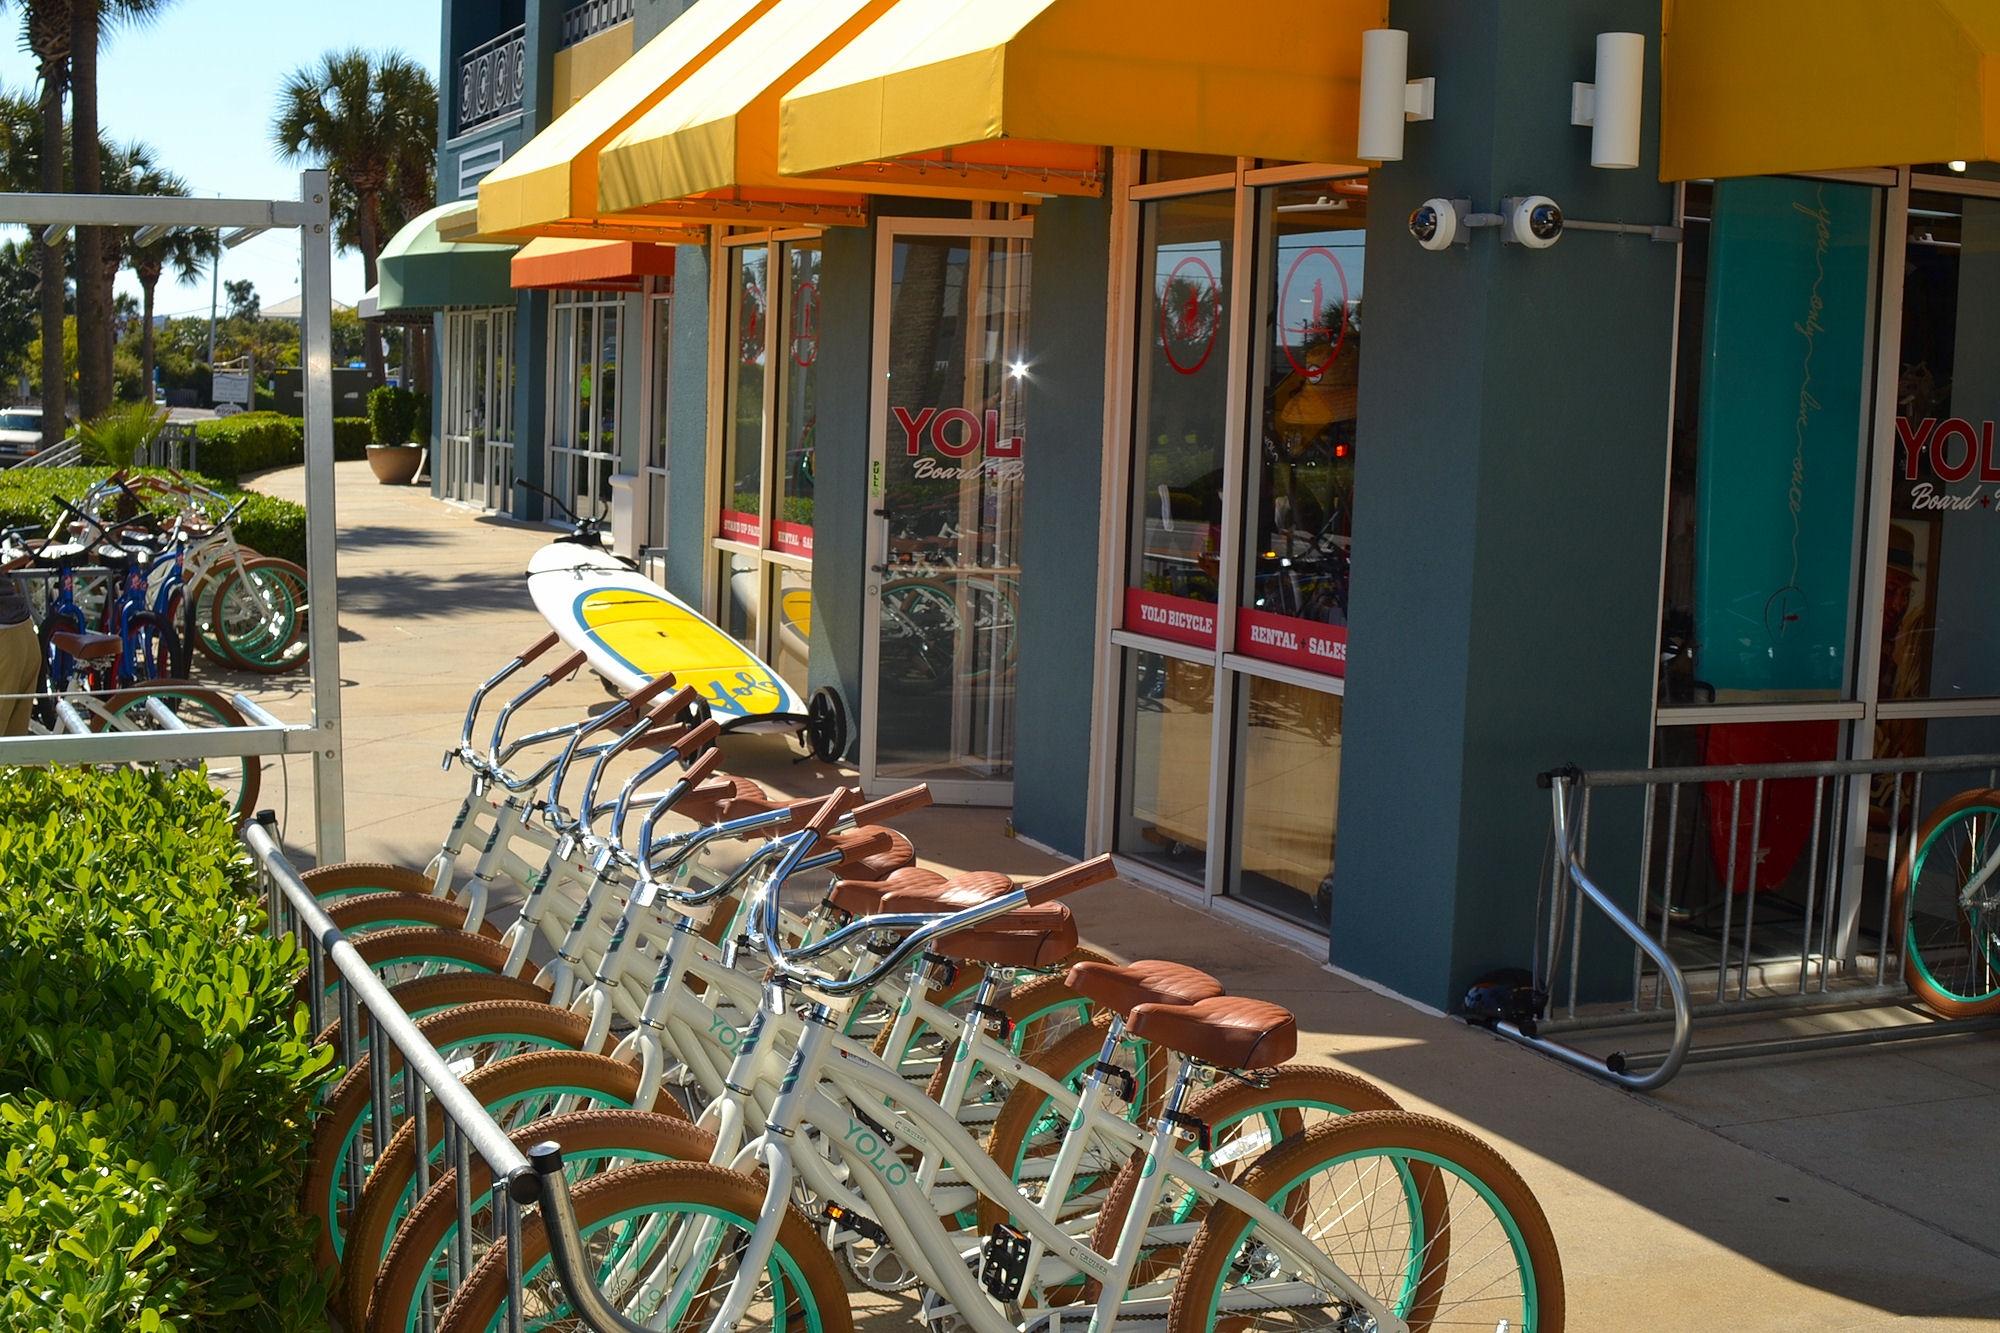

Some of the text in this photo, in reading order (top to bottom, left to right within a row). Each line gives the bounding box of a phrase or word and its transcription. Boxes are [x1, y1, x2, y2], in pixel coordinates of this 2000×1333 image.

[1795, 294, 1825, 337] only
[1799, 389, 1822, 428] live
[891, 406, 1023, 458] YOL
[1895, 416, 2000, 483] YOL
[913, 457, 986, 480] Board
[1788, 458, 1807, 514] once
[1910, 482, 1982, 511] Board
[778, 530, 800, 546] RENTAL
[1140, 604, 1214, 635] YOLO BICYCLE
[1251, 625, 1298, 651] RENTAL
[843, 1118, 907, 1186] YOLO
